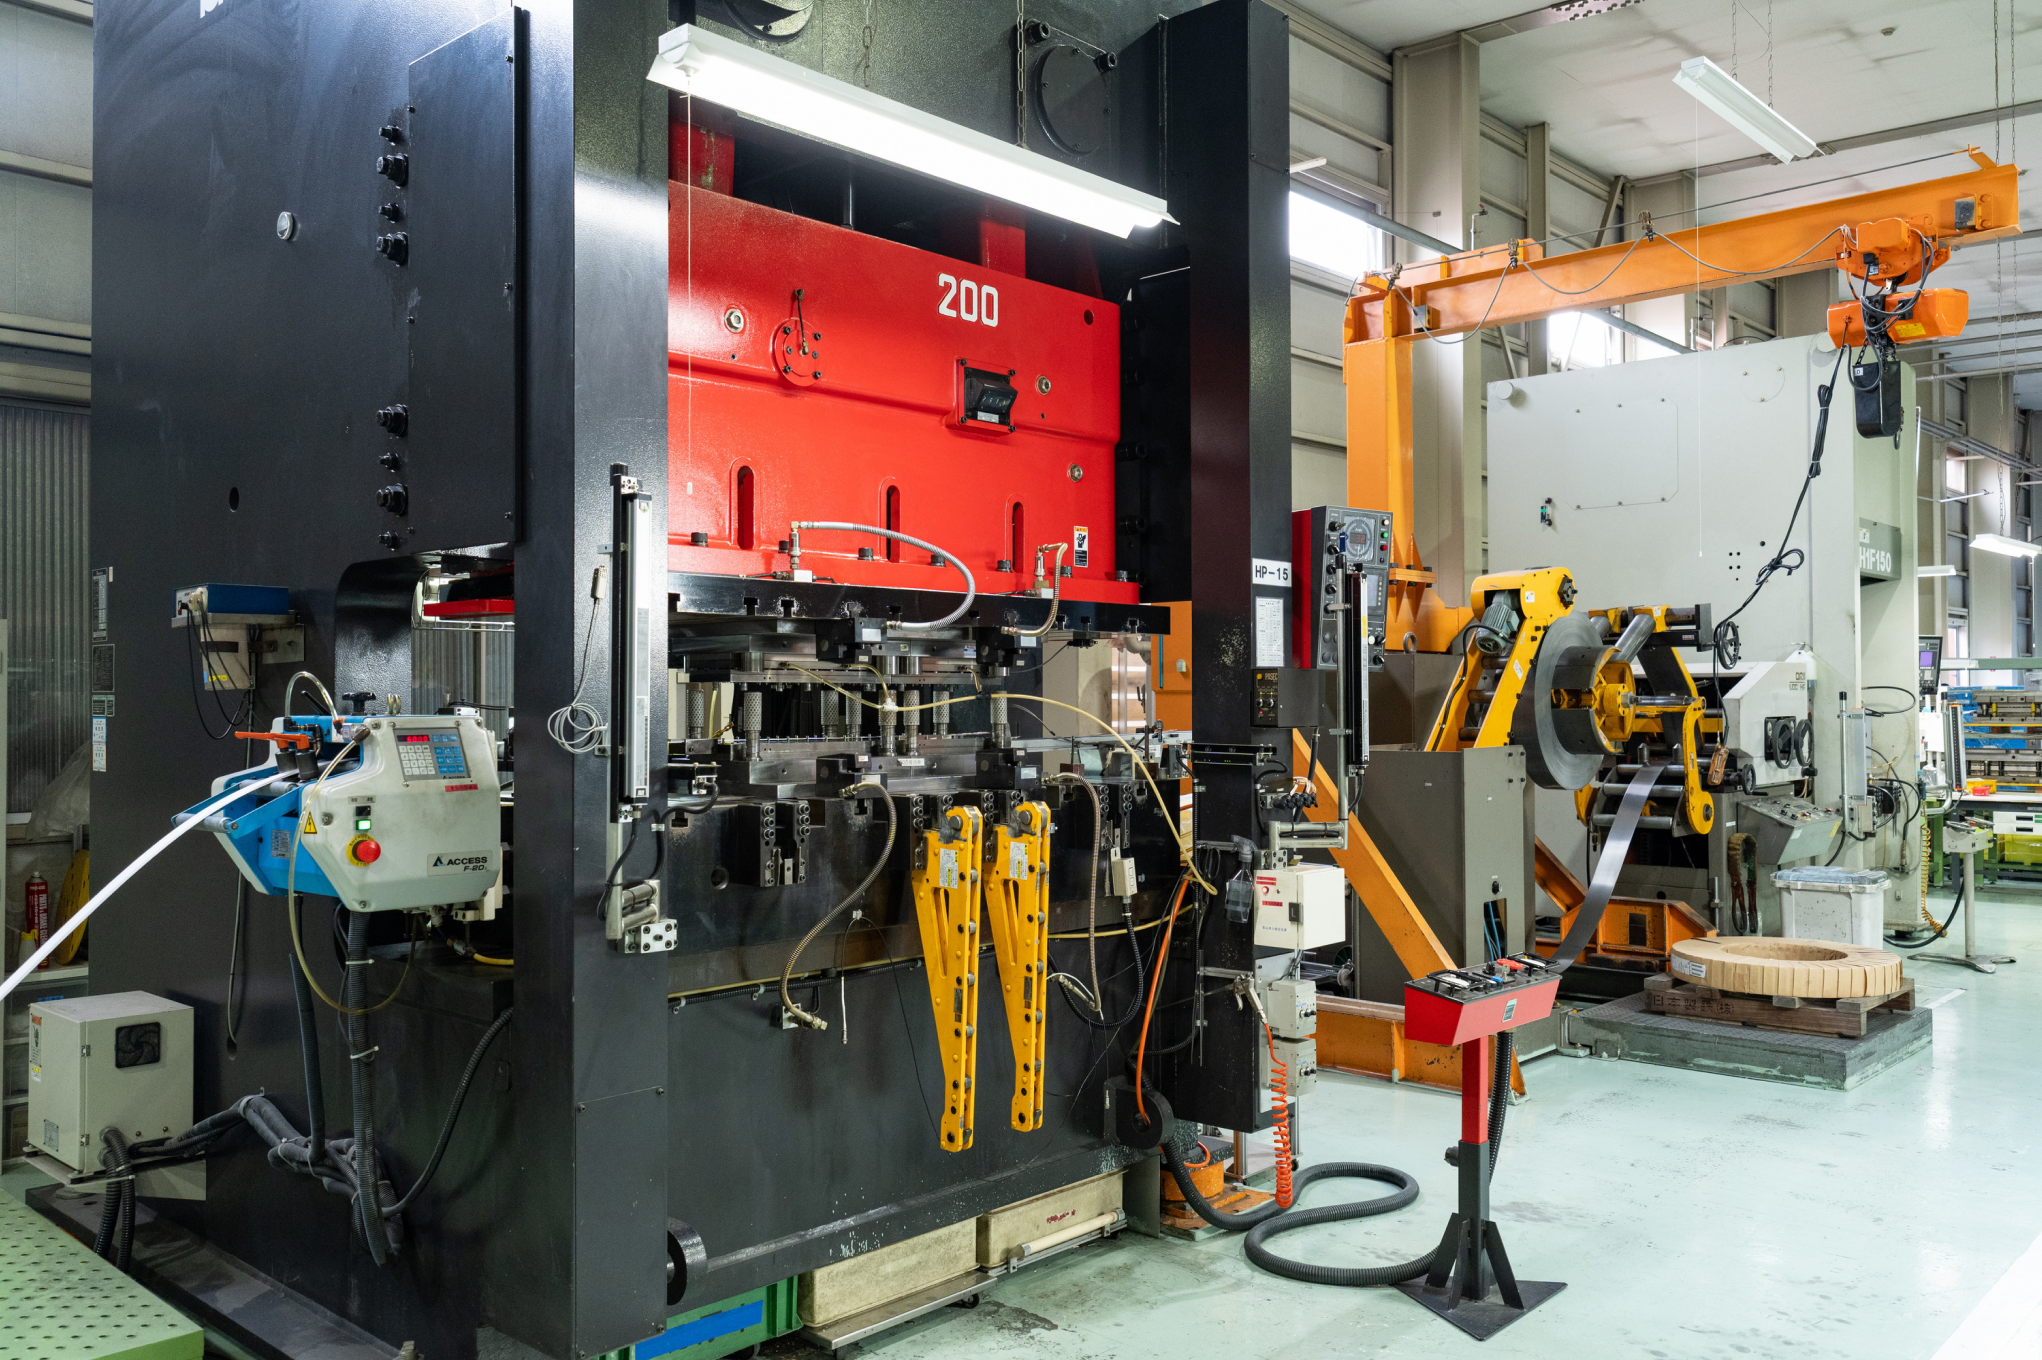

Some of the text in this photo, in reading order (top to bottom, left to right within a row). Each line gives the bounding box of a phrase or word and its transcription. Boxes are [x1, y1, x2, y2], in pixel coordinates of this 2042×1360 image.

[938, 273, 998, 327] 200
[1255, 565, 1288, 581] HP-15
[447, 856, 488, 866] ACCESS
